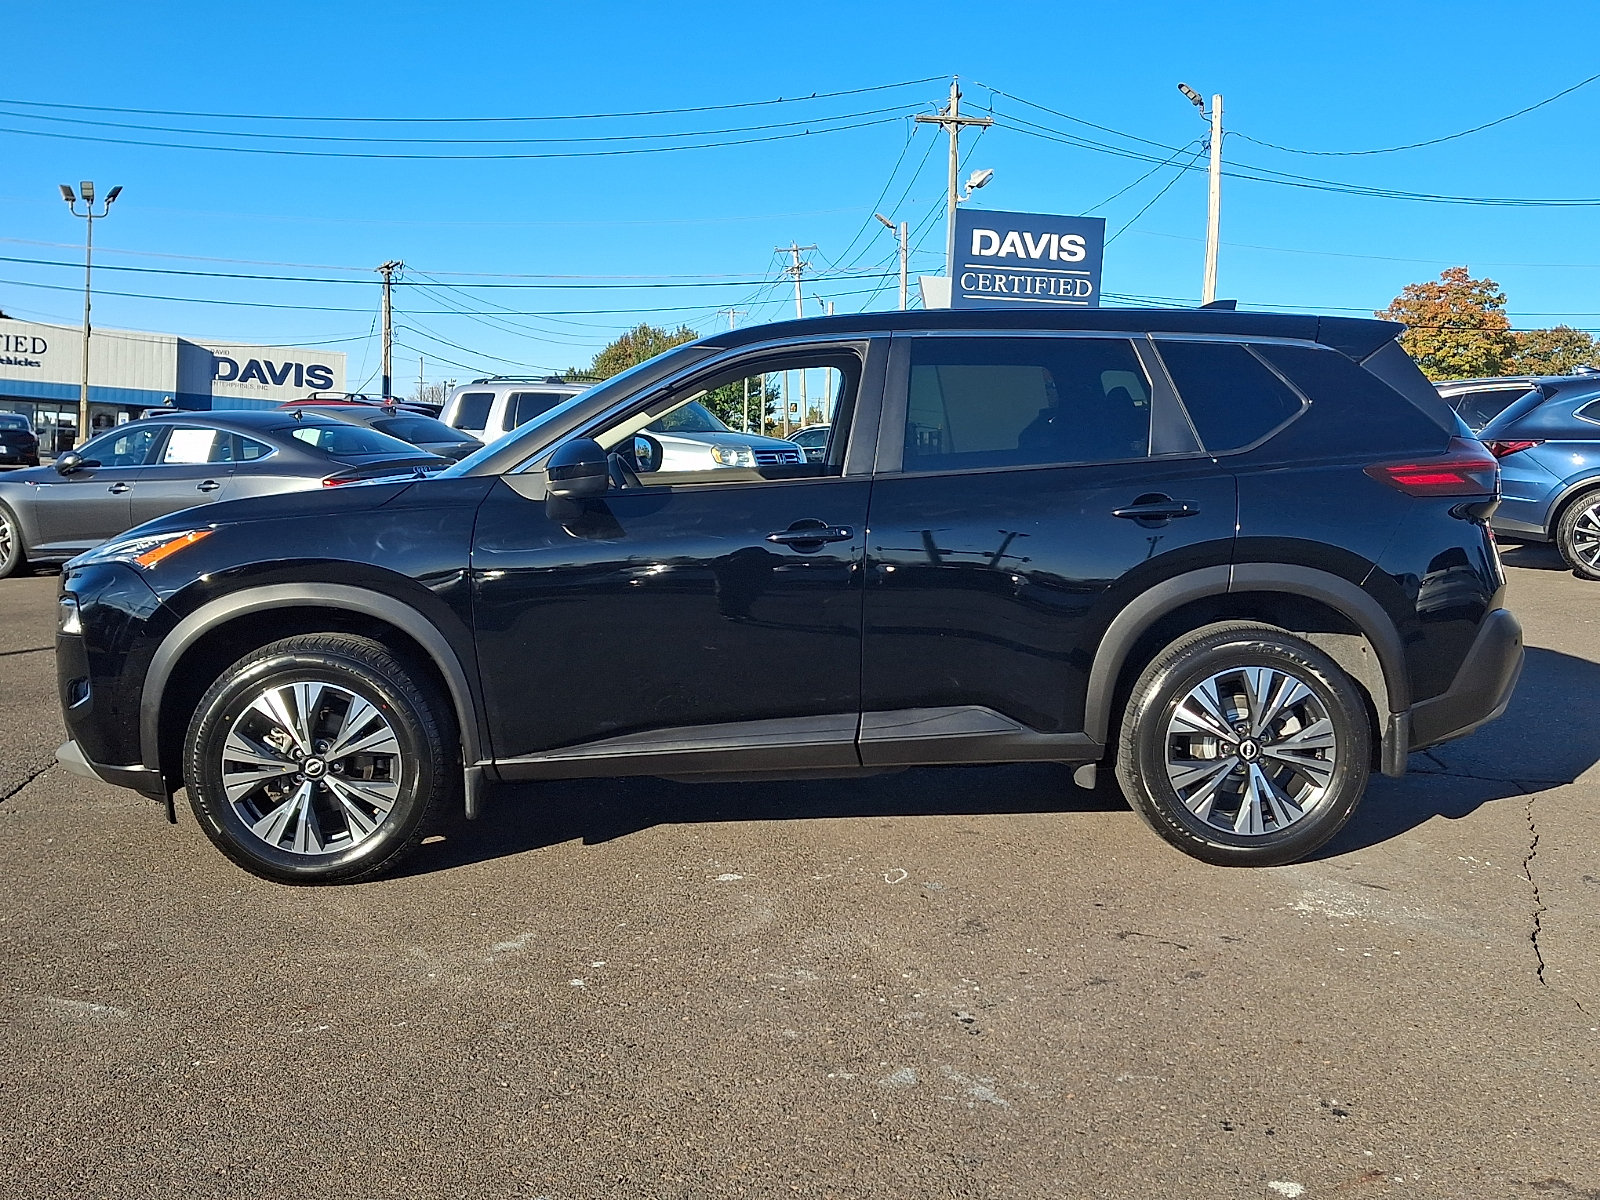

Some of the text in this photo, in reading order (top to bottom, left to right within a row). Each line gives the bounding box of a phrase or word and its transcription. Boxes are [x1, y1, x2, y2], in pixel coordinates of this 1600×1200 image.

[971, 228, 1086, 262] DAVIS
[960, 272, 1093, 297] CERTIFIED
[0, 333, 48, 355] IED
[0, 355, 41, 368] ehicles
[212, 356, 334, 390] DAVIS
